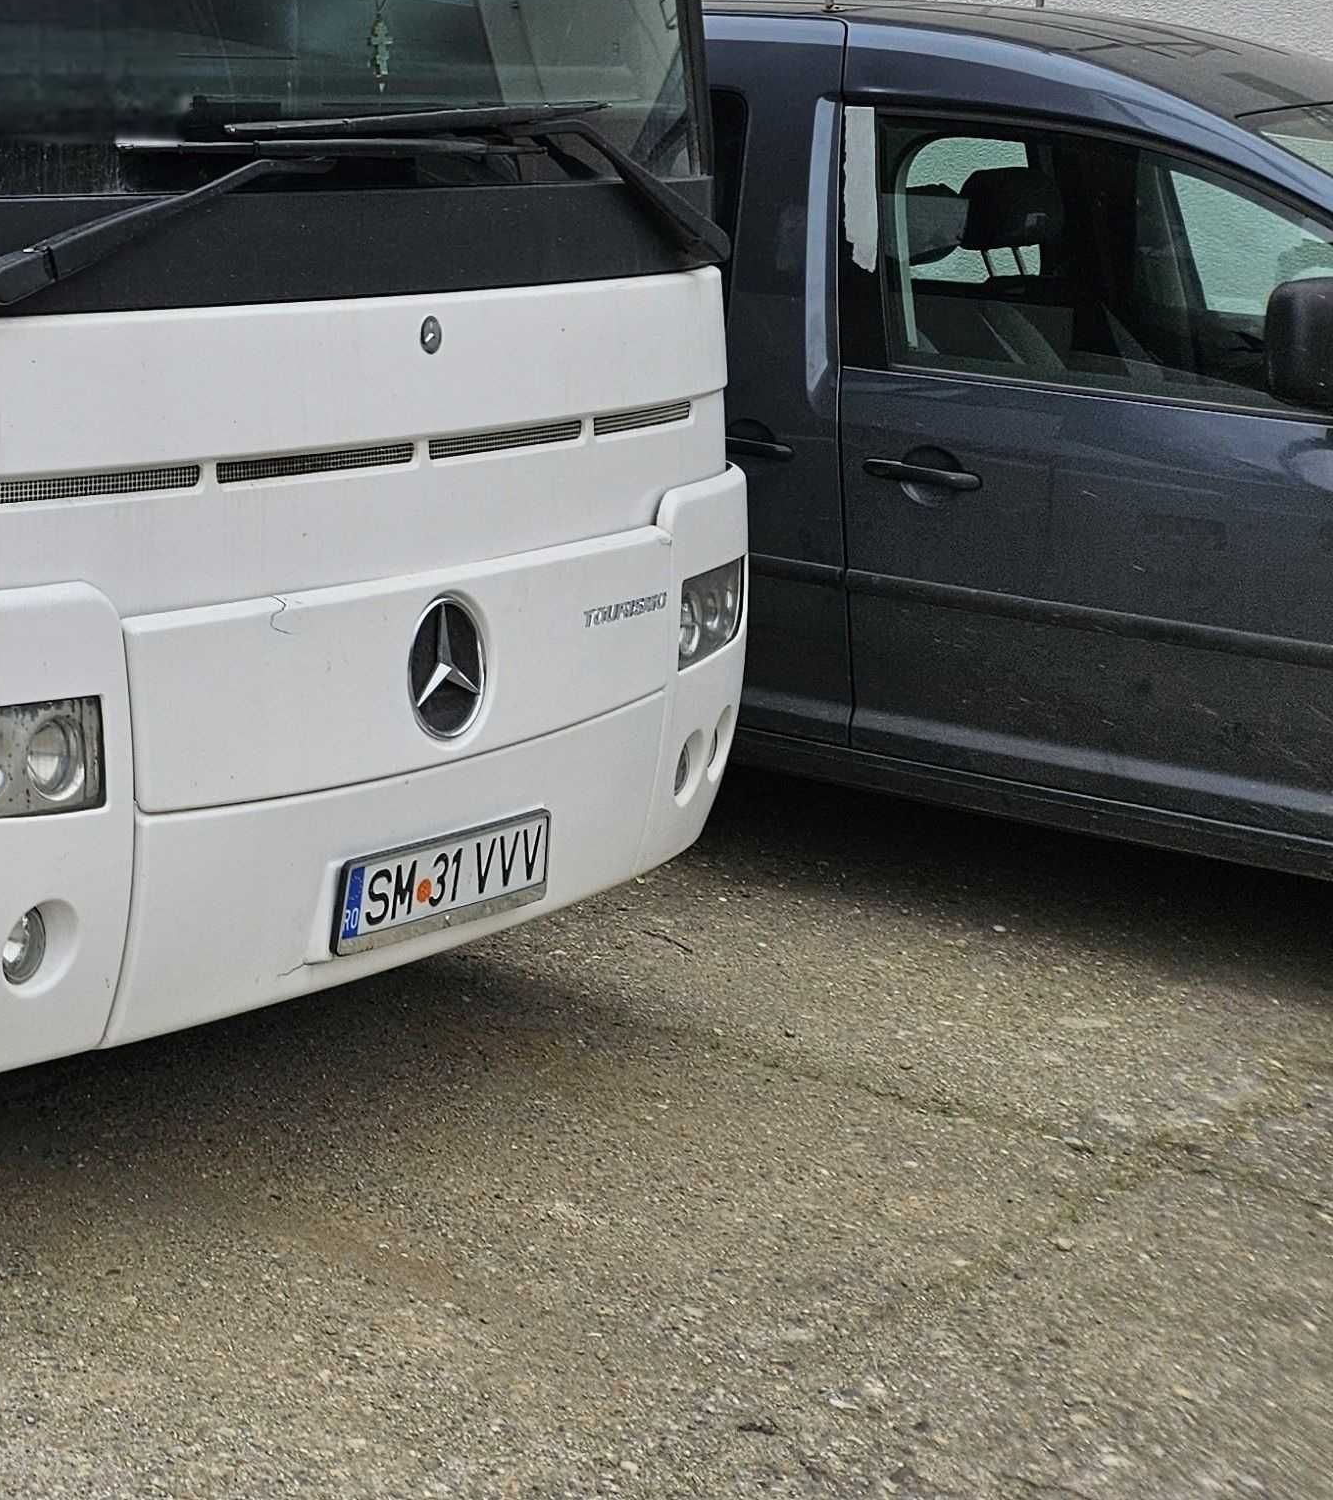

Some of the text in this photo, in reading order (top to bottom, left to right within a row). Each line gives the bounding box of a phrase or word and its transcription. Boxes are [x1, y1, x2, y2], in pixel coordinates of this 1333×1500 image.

[583, 592, 667, 628] TOURISMO
[365, 825, 542, 926] SM 31 VVV
[343, 908, 359, 931] RO
